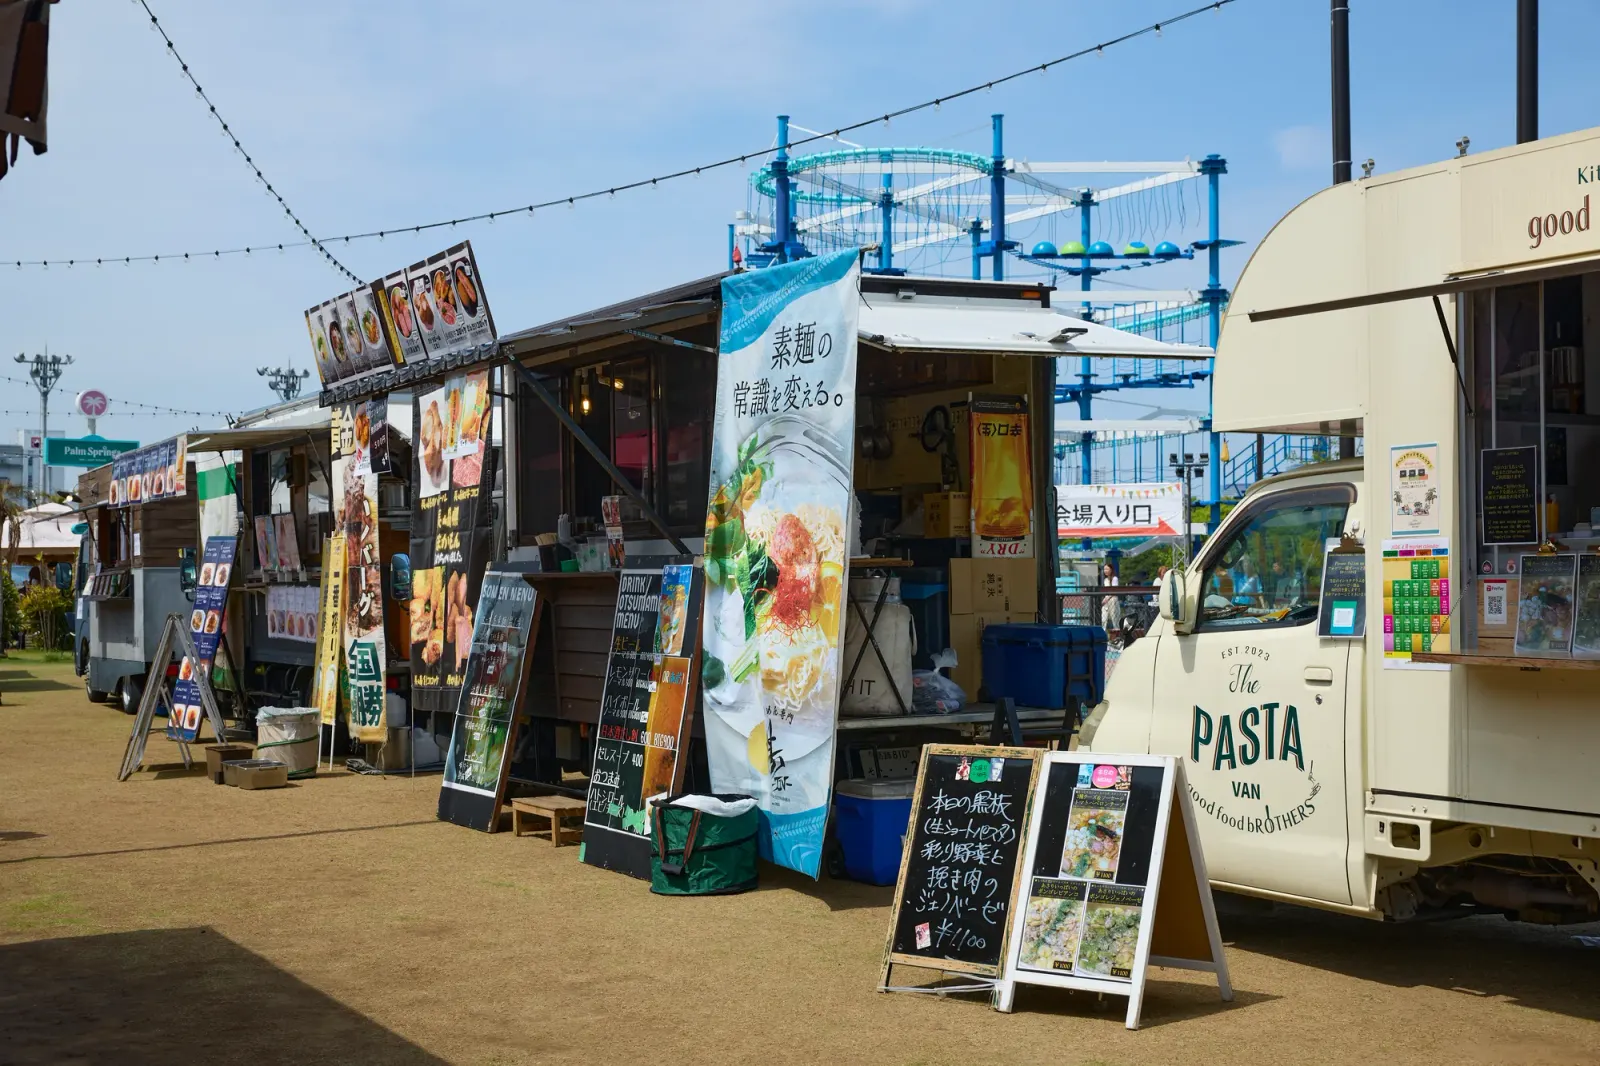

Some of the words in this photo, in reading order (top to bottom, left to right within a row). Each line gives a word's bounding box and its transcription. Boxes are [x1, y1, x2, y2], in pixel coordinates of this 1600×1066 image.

[1528, 194, 1590, 249] good
[771, 321, 832, 370] 素麺の
[734, 375, 843, 418] 常識を変える。
[64, 446, 86, 456] Palm
[1057, 504, 1152, 525] 会場入り口
[616, 612, 640, 629] MENU
[1228, 662, 1262, 694] The
[604, 694, 640, 711] ハイボール
[1191, 702, 1305, 772] PASTA
[926, 787, 1015, 822] 本日の黒板
[1231, 780, 1261, 800] VAN
[1216, 804, 1244, 831] food
[927, 865, 998, 898] 挽き肉の
